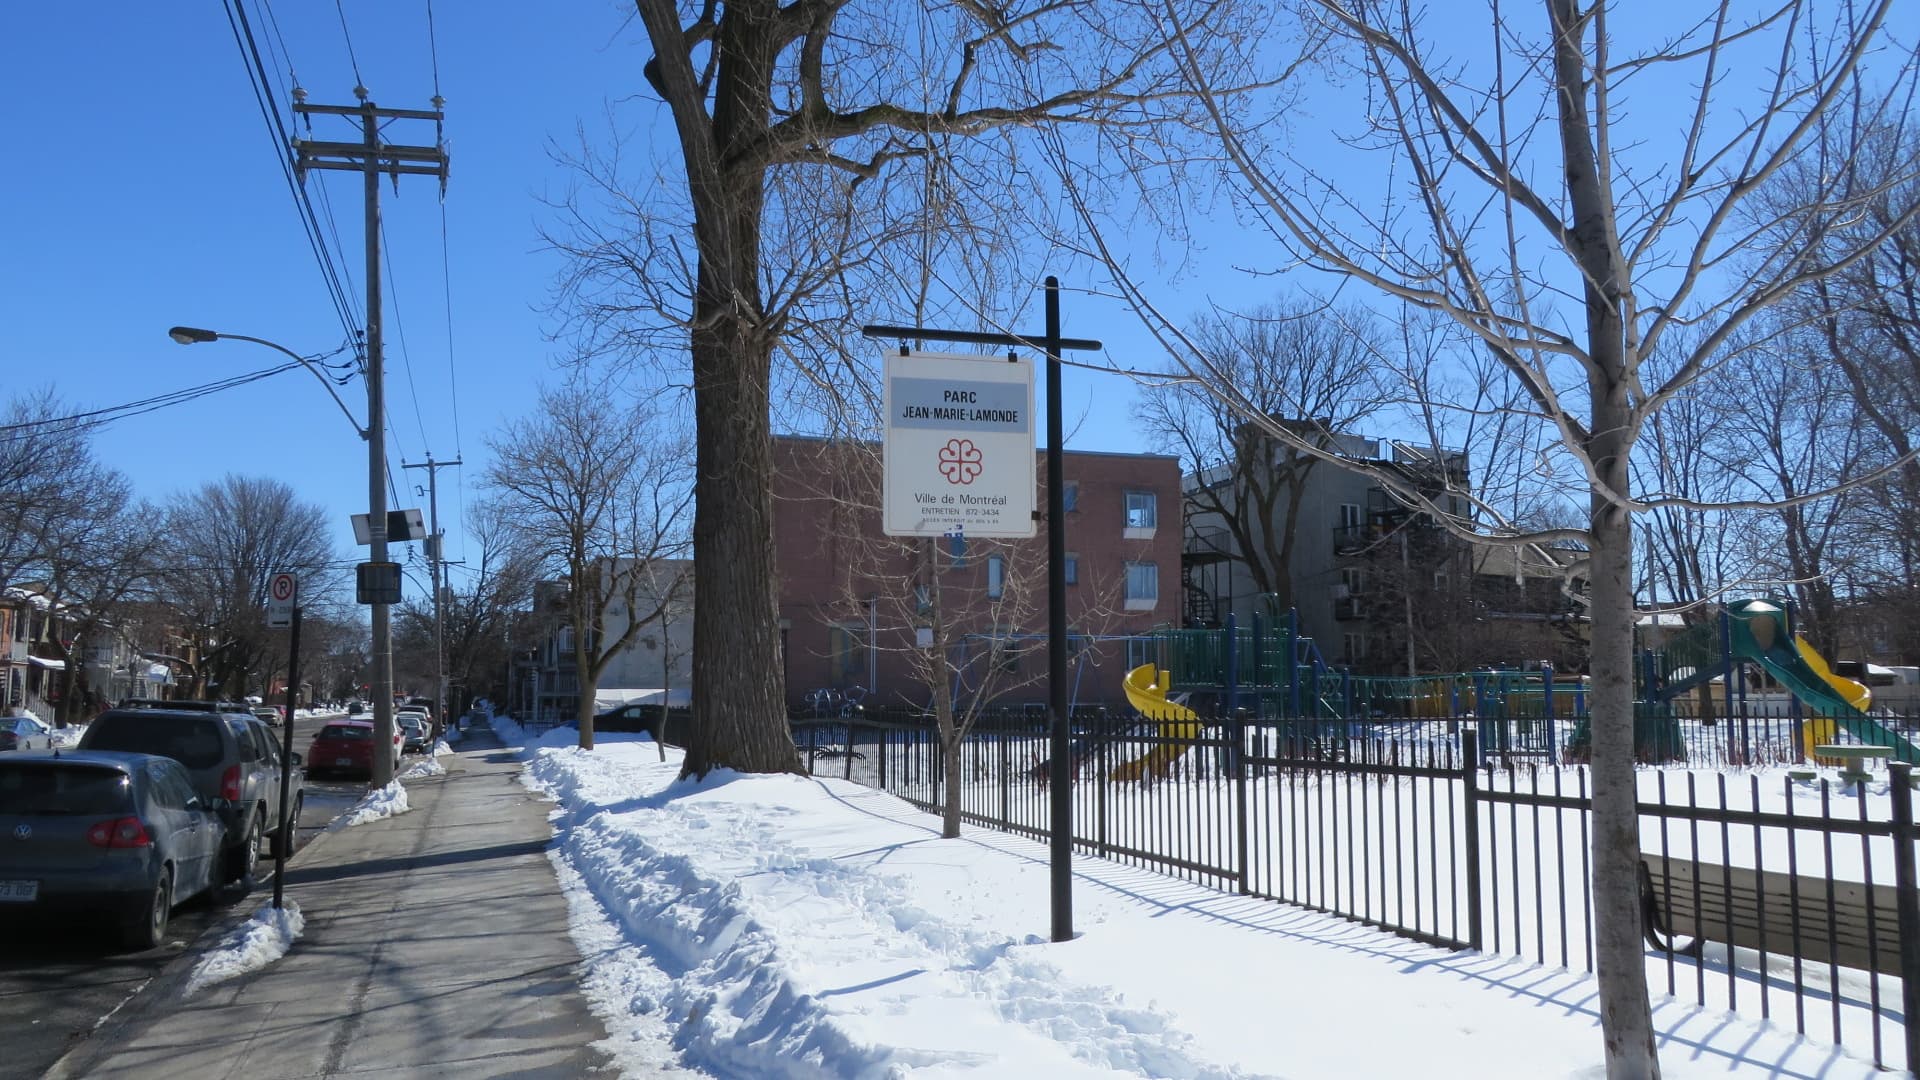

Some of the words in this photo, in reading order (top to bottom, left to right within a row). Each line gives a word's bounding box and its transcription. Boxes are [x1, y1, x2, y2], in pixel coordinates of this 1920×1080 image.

[944, 390, 977, 404] PARC
[903, 406, 1018, 423] JEAN-MARIE-LAMONDE
[914, 492, 937, 504] Ville
[941, 493, 955, 504] de
[959, 493, 1007, 506] Montréal
[921, 507, 960, 516] ENTRETIEN
